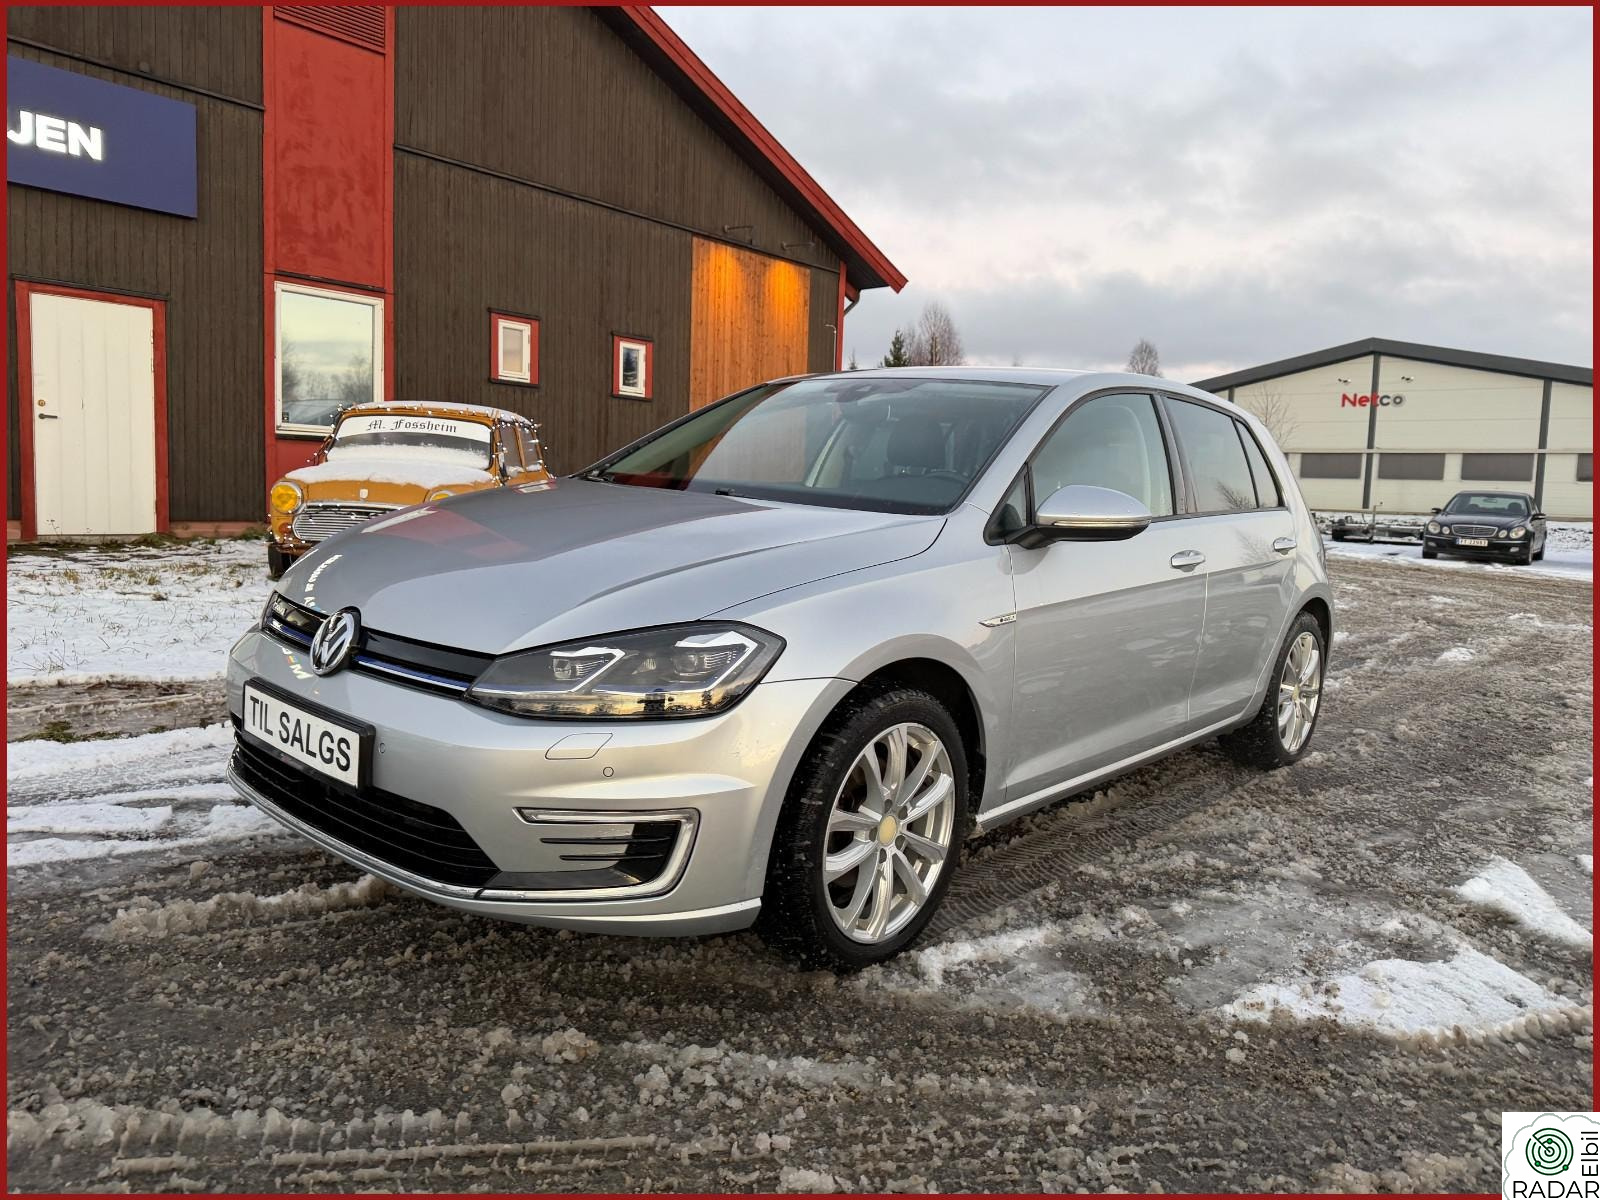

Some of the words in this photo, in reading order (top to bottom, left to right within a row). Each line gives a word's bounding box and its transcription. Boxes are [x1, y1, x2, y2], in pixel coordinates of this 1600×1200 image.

[7, 110, 102, 161] JEN
[1341, 393, 1403, 408] Netco
[389, 419, 457, 433] Fossheim
[250, 695, 273, 737] TIL
[278, 711, 351, 772] SALGS
